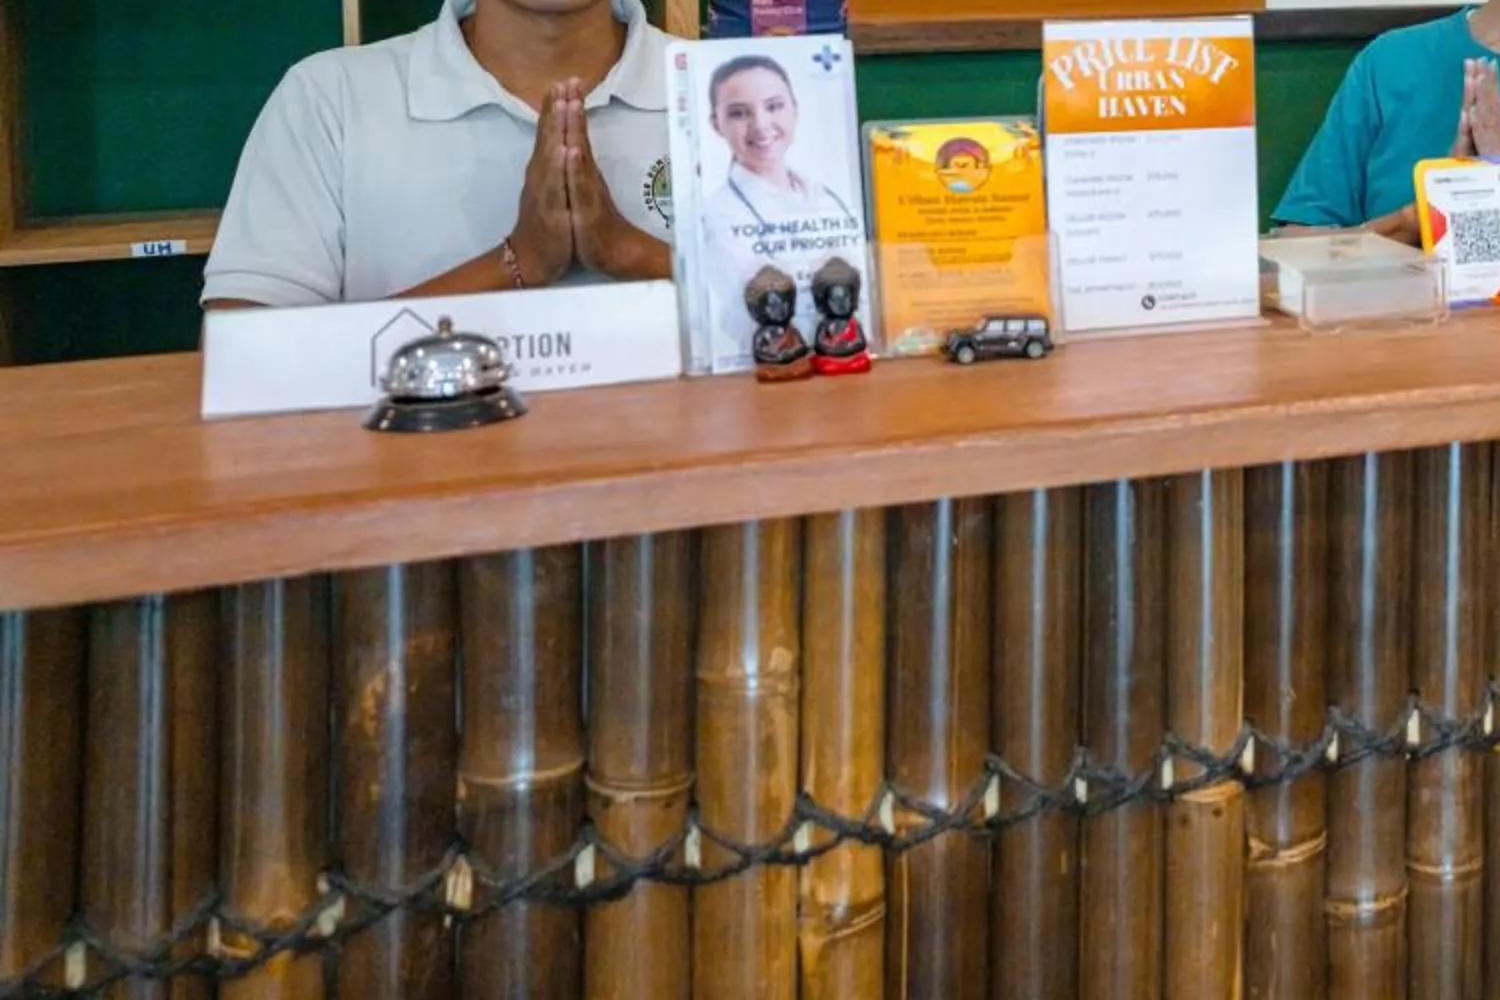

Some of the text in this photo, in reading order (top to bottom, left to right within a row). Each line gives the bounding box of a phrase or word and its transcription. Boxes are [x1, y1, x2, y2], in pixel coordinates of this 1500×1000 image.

[1049, 36, 1239, 91] PRICE LIST
[1098, 96, 1187, 119] HAVEN
[731, 223, 776, 237] YOUR
[779, 217, 841, 235] HEALTH
[752, 234, 859, 255] OUR PRIORITY
